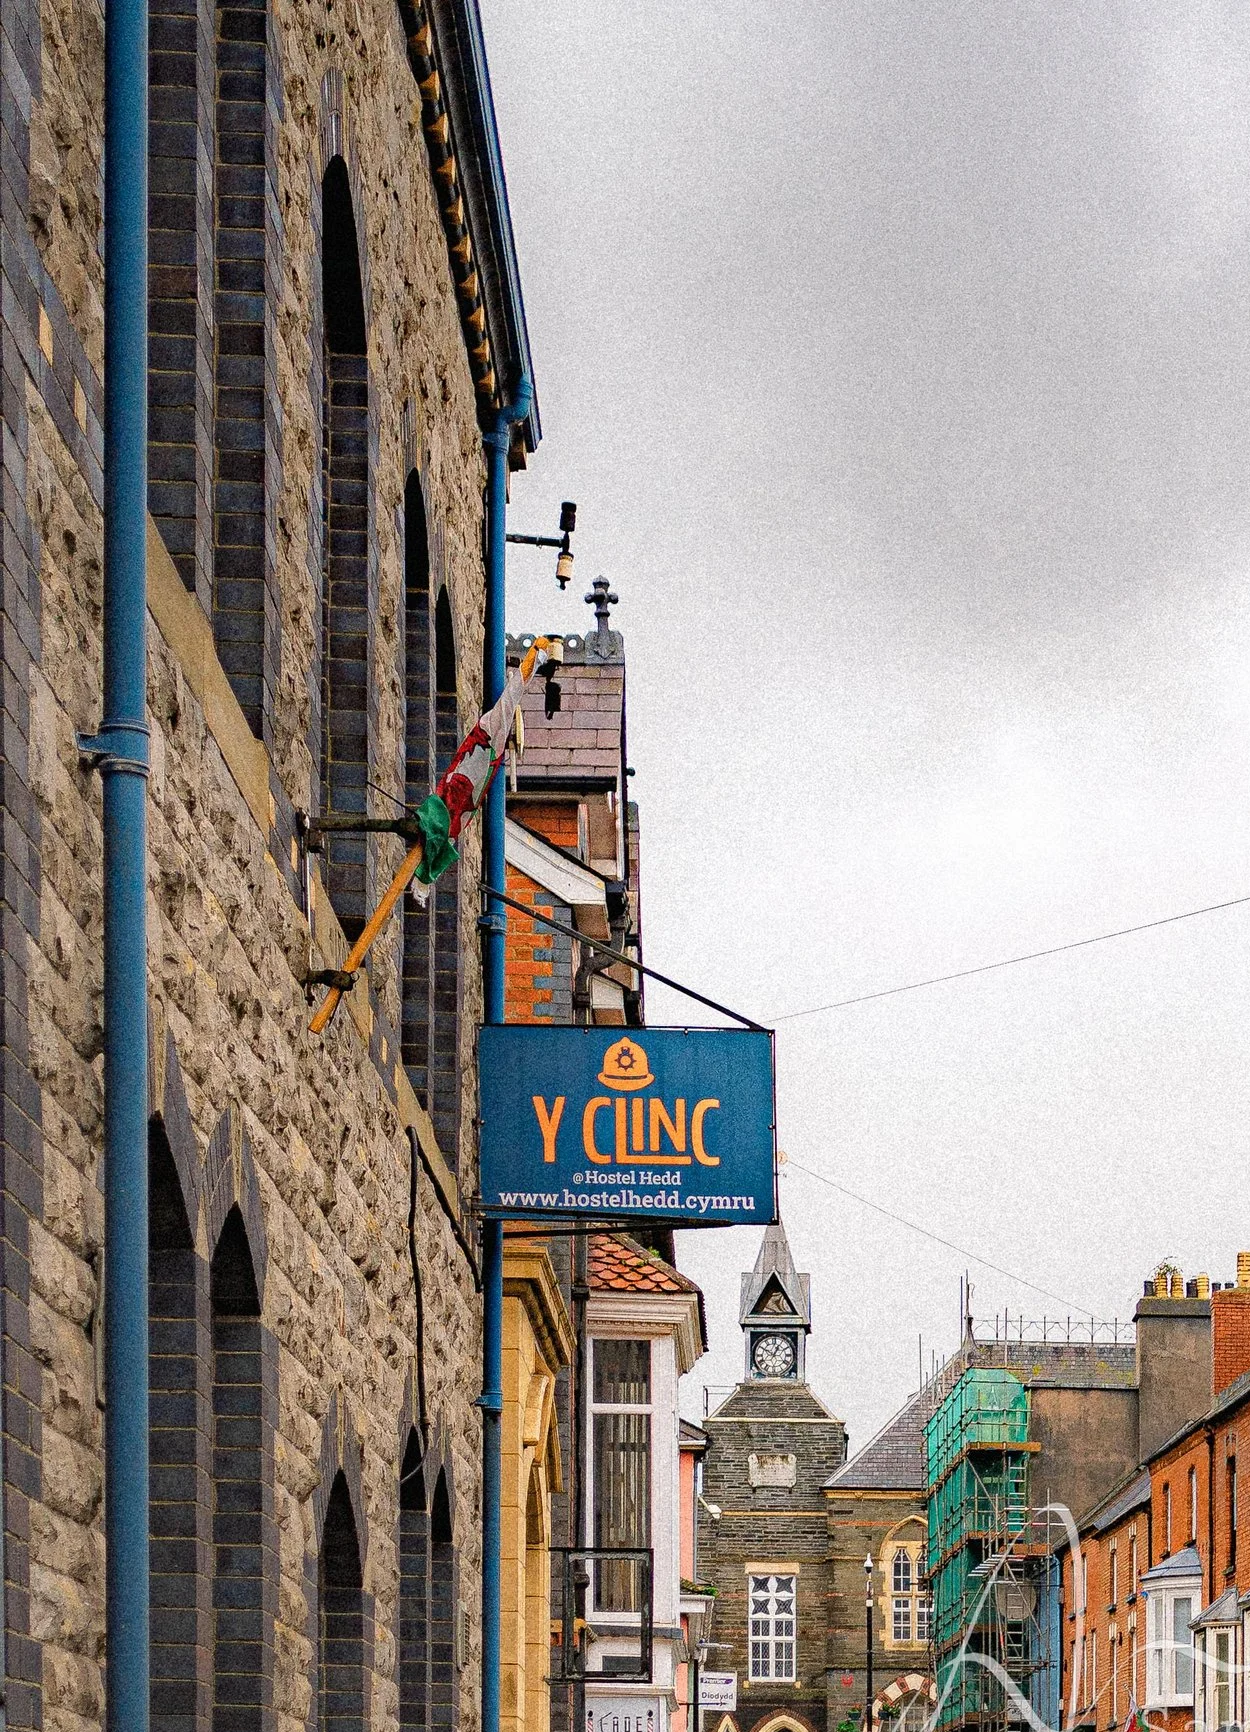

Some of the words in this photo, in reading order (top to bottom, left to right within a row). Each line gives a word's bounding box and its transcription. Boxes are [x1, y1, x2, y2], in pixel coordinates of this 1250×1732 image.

[532, 1096, 566, 1164] Y
[582, 1097, 721, 1166] CLINC
[639, 1171, 682, 1187] Hedd
[498, 1189, 756, 1213] www.hostelhedd.cymru
[701, 1691, 734, 1700] Diodydd
